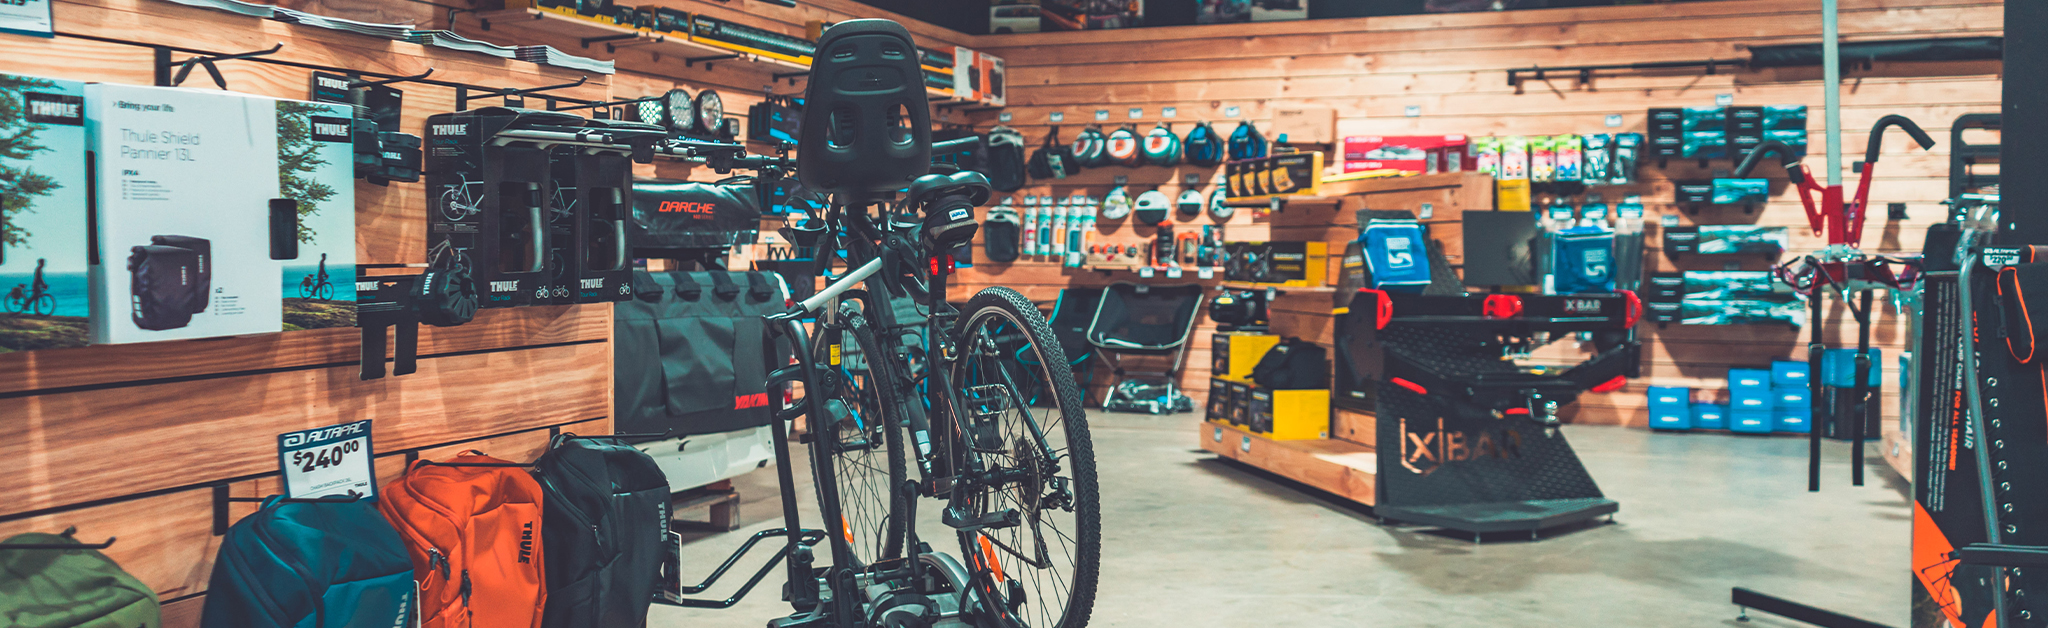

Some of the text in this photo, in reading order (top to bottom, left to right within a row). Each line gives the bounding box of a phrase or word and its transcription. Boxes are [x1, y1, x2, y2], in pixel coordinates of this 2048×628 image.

[317, 76, 349, 90] THULE
[29, 100, 79, 118] THULE
[120, 128, 200, 145] Thule Shield
[314, 122, 348, 136] THULE
[432, 124, 467, 135] THULE
[120, 145, 195, 161] Pannier 13L
[382, 151, 402, 160] THU
[658, 201, 715, 214] DARCHE
[355, 281, 378, 291] THULE
[422, 272, 435, 295] THULE
[490, 281, 518, 292] THULE
[580, 278, 603, 289] THULE
[734, 392, 769, 410] YAKIM
[306, 421, 366, 443] ALTAPAC
[657, 501, 668, 542] THULE
[518, 521, 533, 564] THULE
[391, 591, 409, 628] THU
